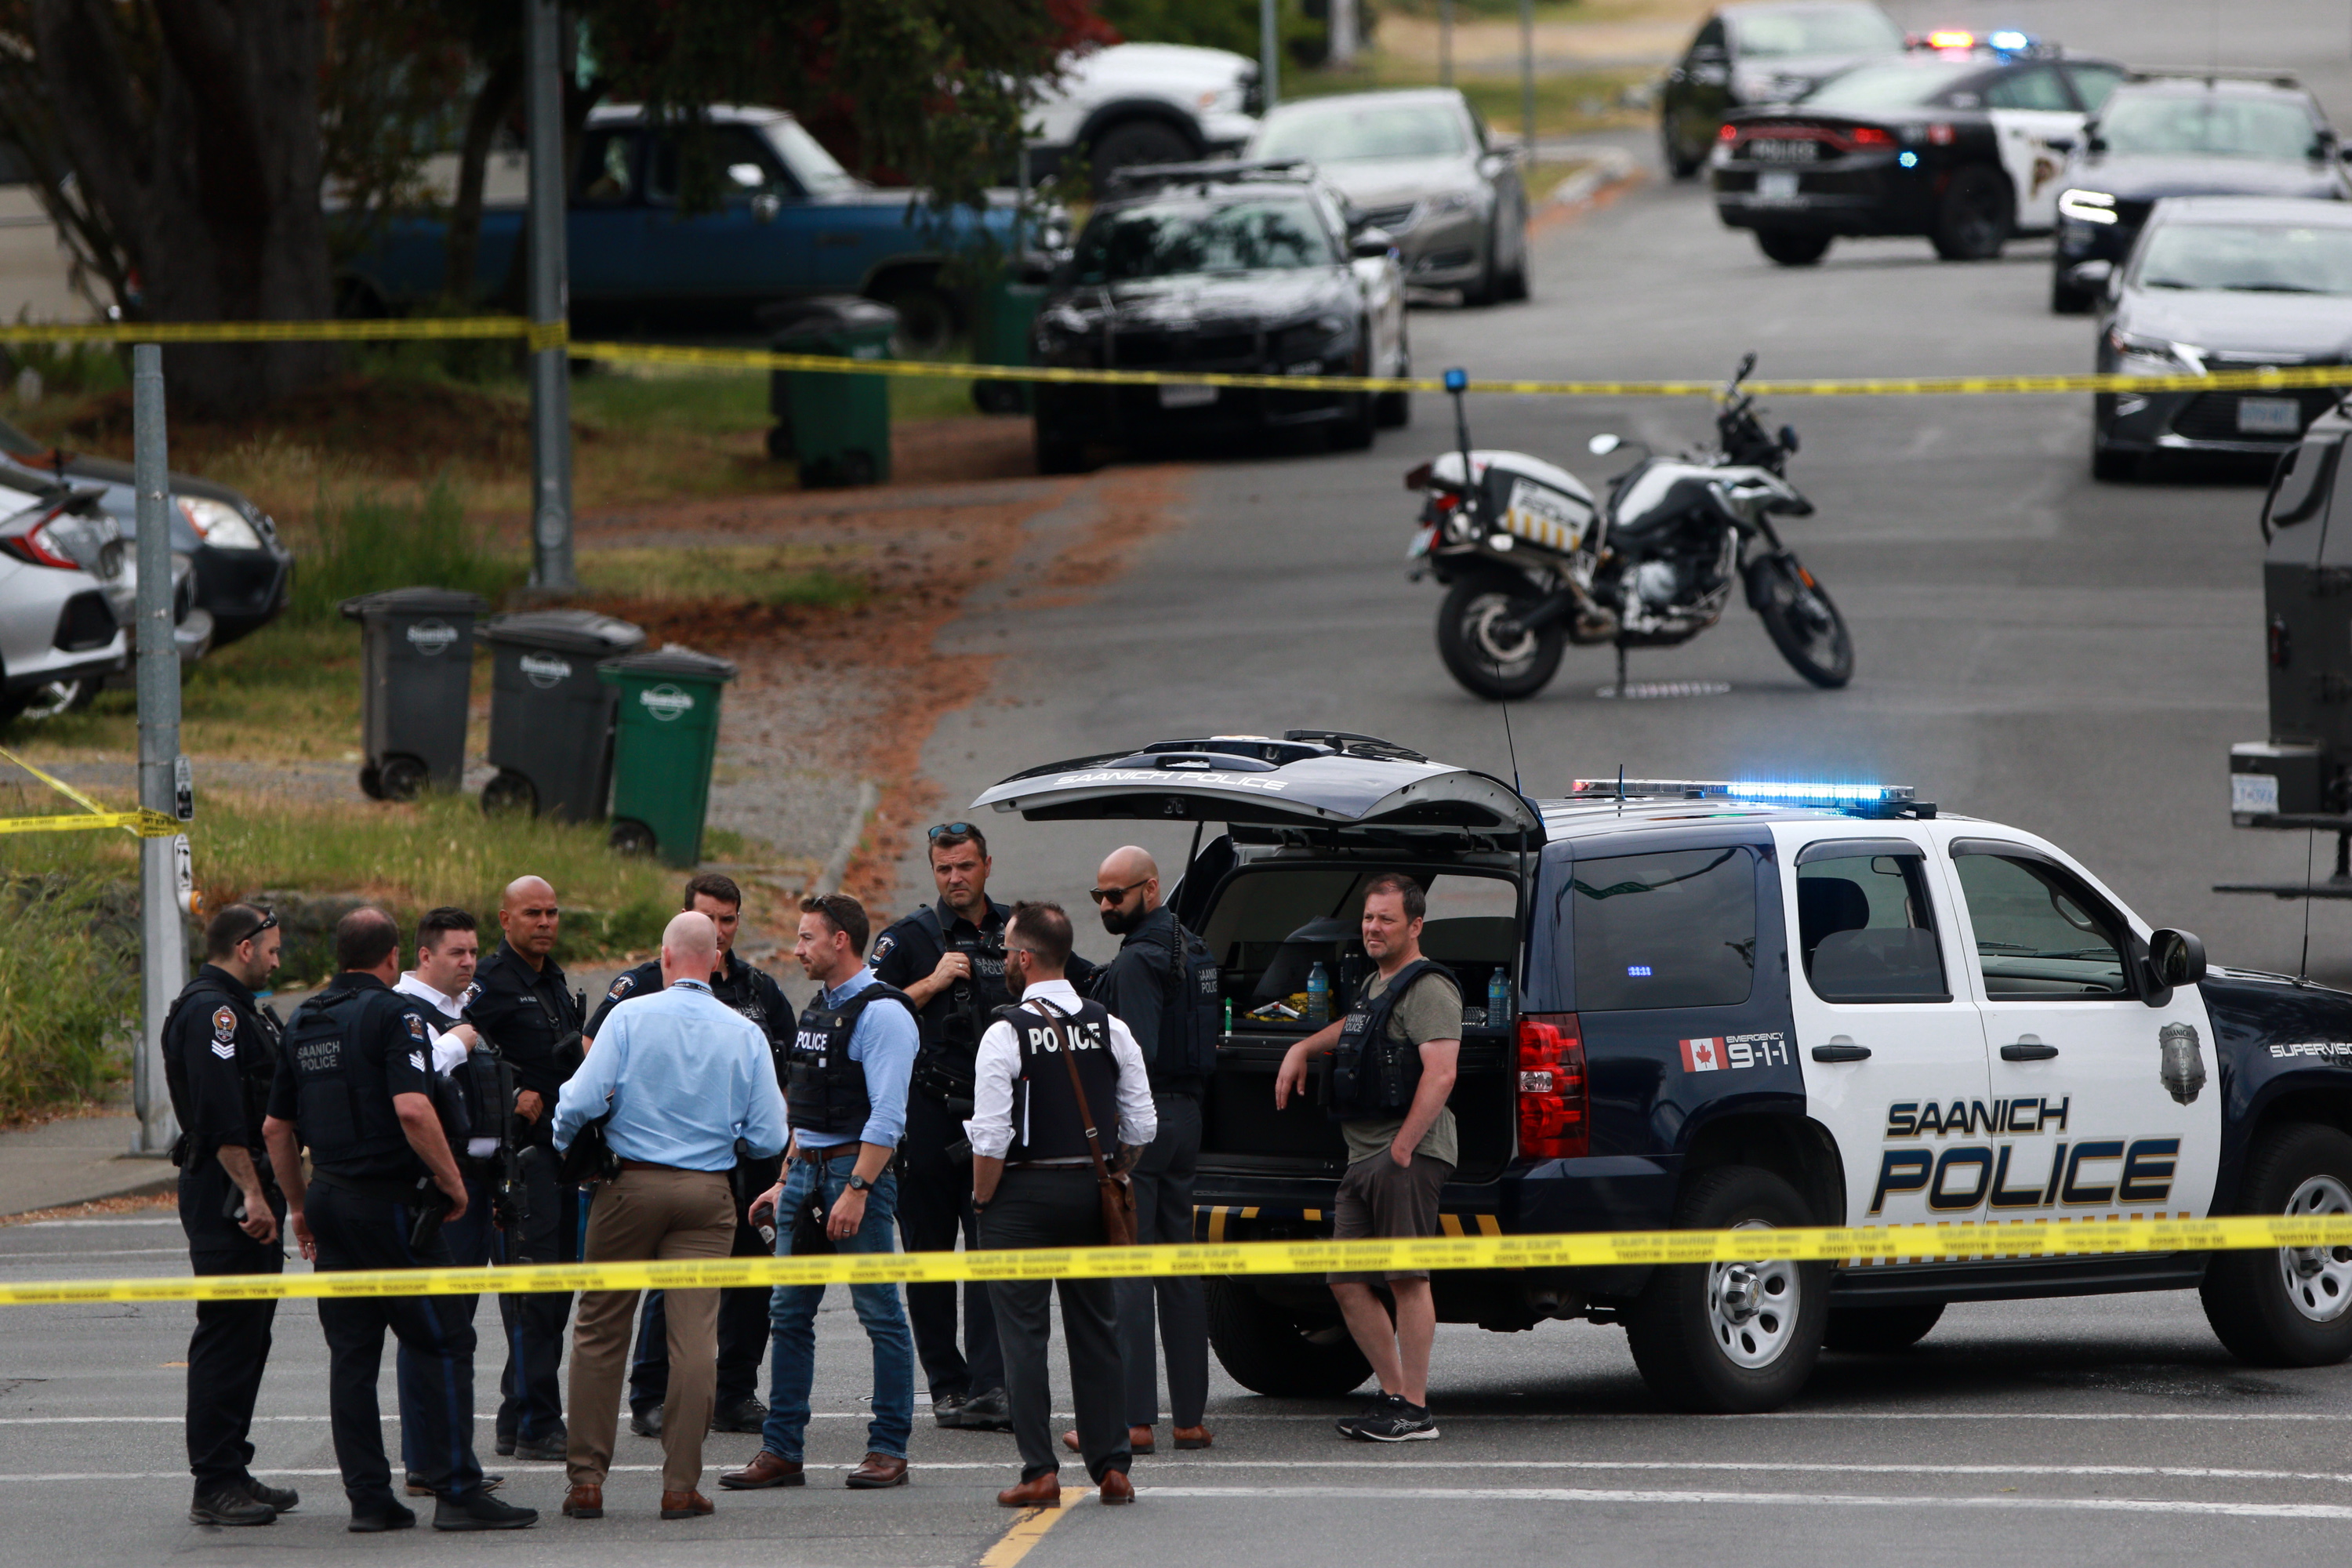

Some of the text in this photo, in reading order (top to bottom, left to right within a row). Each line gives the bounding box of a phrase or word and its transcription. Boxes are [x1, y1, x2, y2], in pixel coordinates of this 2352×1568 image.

[1054, 771, 1289, 791] SAANICH POLICE
[795, 1030, 828, 1051] POLICE
[1028, 1022, 1102, 1055] POICE
[1726, 1032, 1784, 1044] EMERGENCY
[2165, 1029, 2190, 1038] SAANICH
[297, 1040, 340, 1058] SAANICH
[1728, 1040, 1788, 1069] 9-1-1
[301, 1055, 338, 1072] POLICE
[2172, 1083, 2196, 1091] POLICE
[1885, 1095, 2071, 1138] SAANICH
[1868, 1137, 2181, 1214] POLICE
